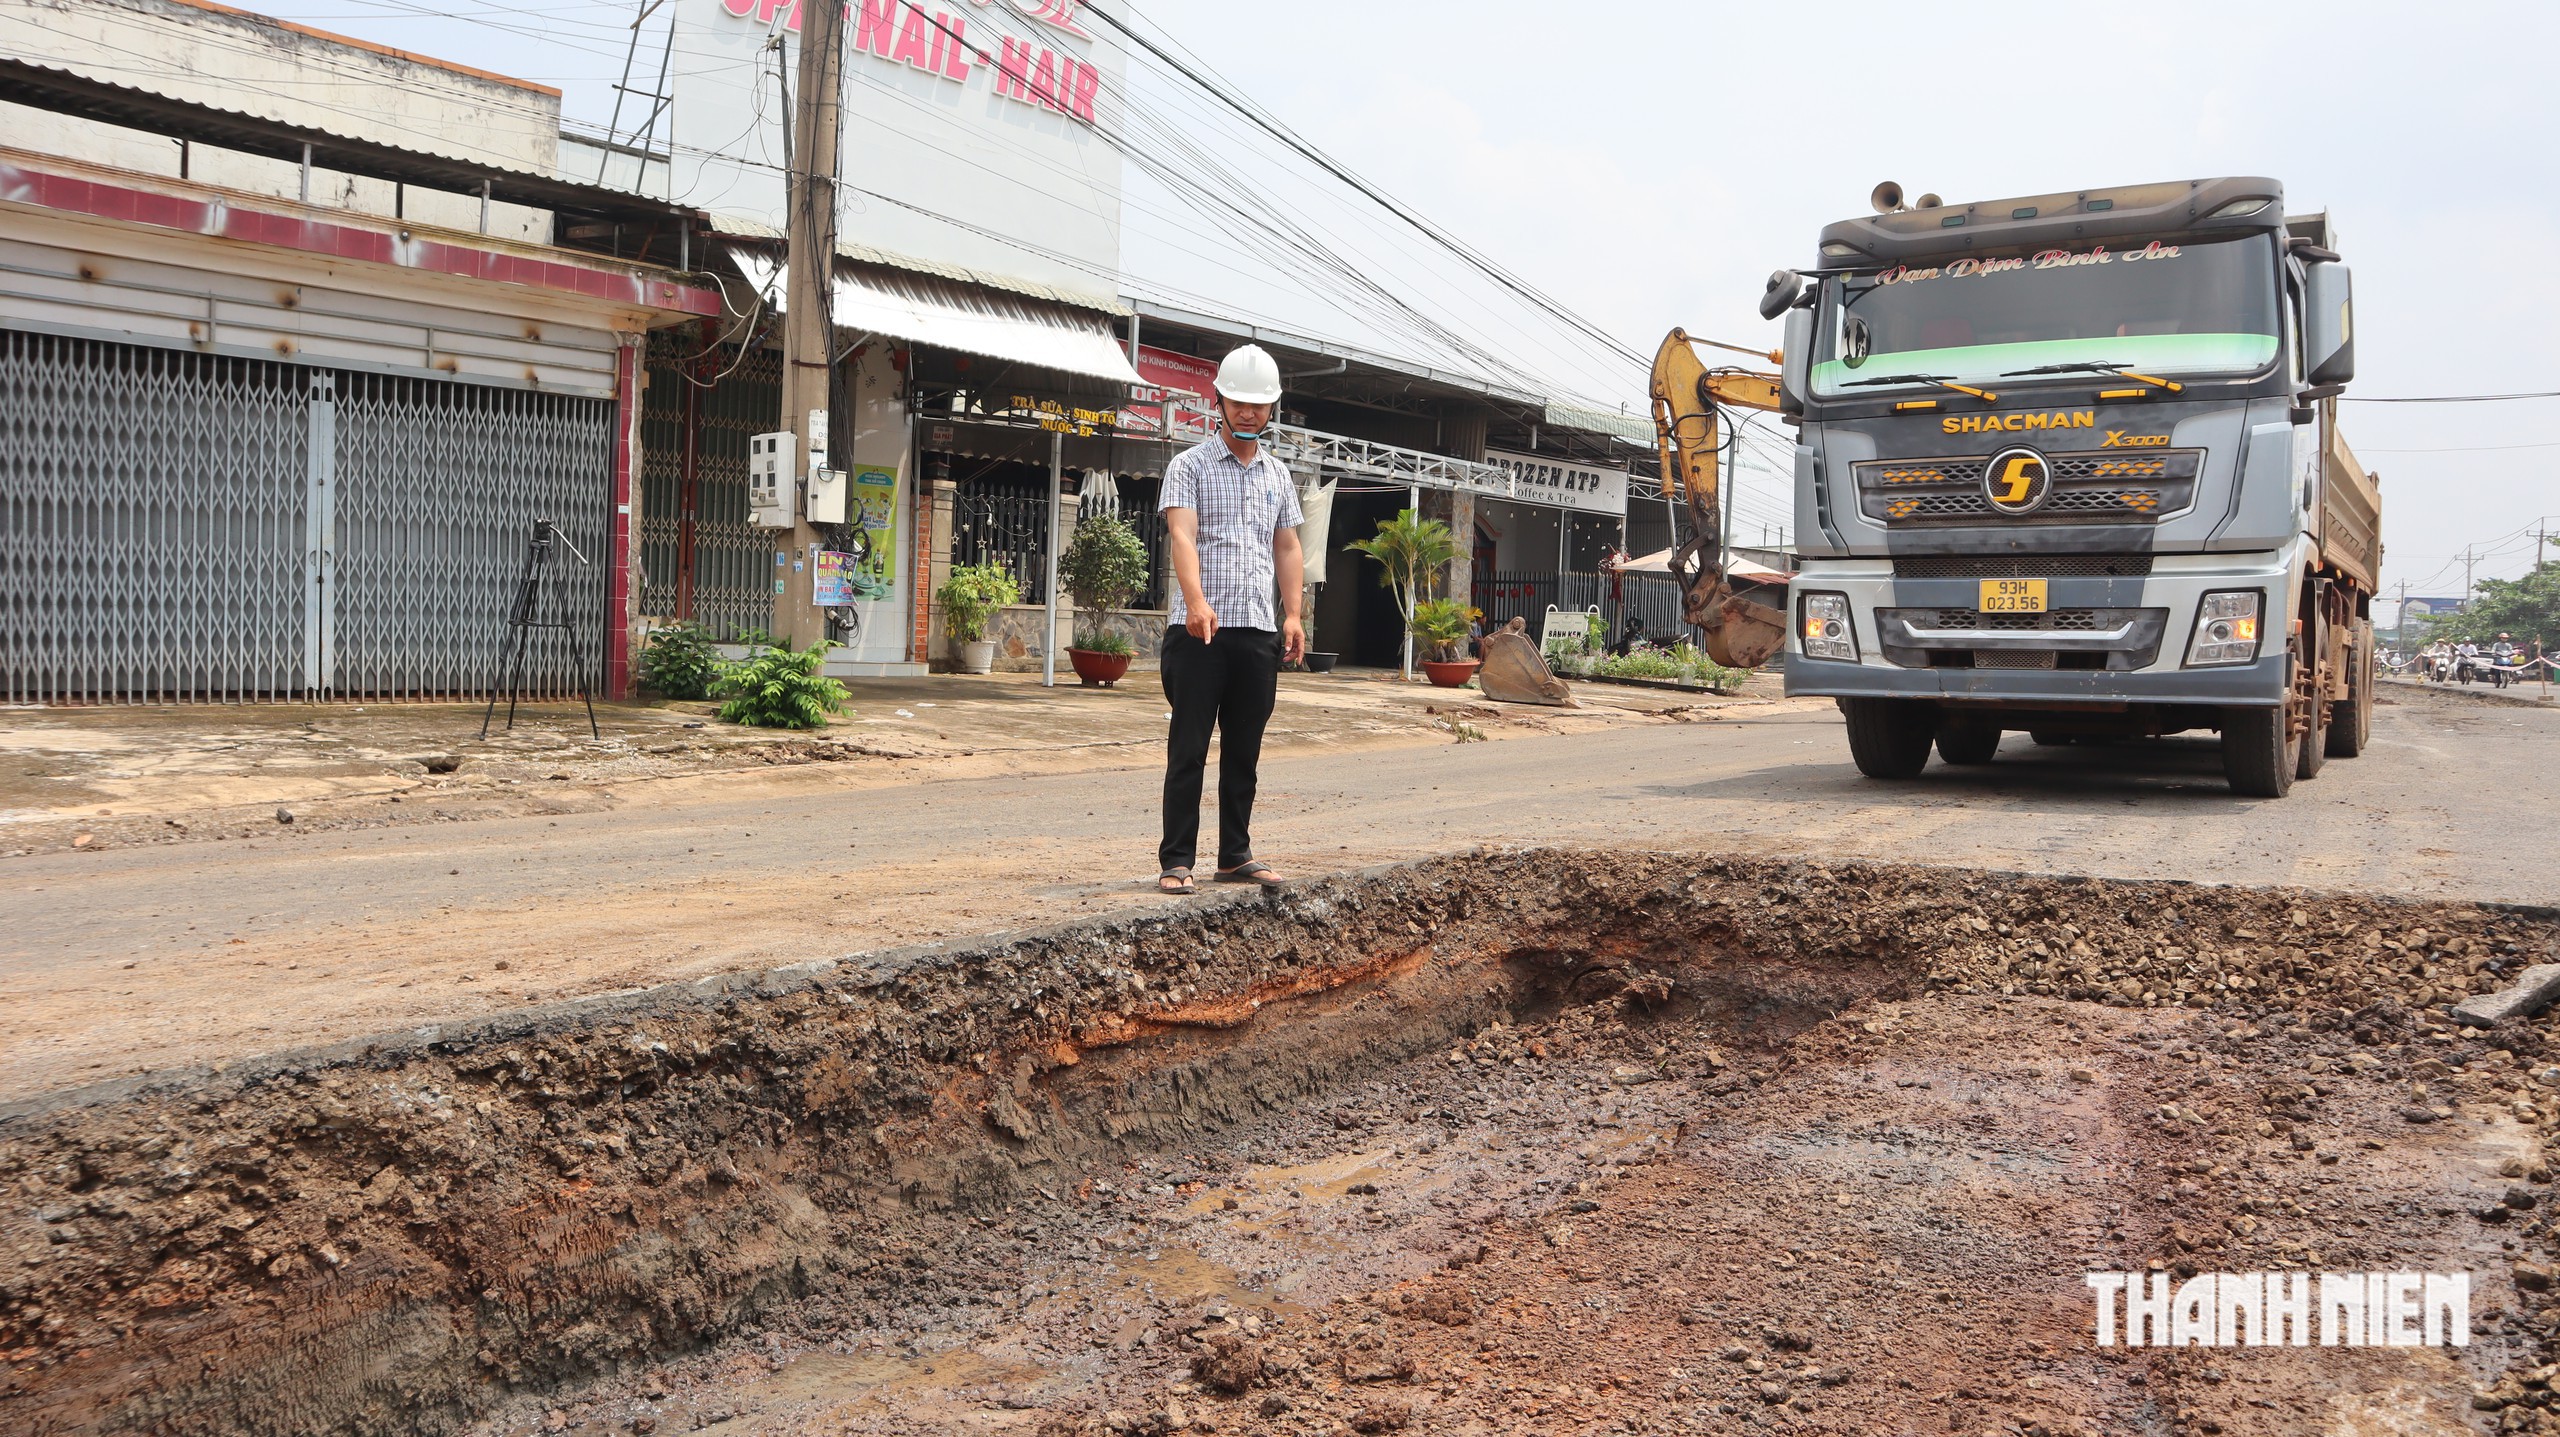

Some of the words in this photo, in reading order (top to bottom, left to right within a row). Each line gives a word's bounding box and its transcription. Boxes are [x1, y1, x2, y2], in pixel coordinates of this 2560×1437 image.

[2121, 240, 2182, 262] An
[1149, 356, 1167, 367] KINH
[1168, 361, 1194, 374] DOANH
[1195, 366, 1209, 377] LPG
[1011, 395, 1036, 409] TRÀ
[1073, 408, 1100, 423] SINH
[1102, 411, 1117, 425] TỐ
[1079, 423, 1093, 437] ÉP
[1942, 411, 2095, 434] SHACMAN
[2100, 430, 2170, 448] X3000
[1565, 470, 1600, 494] ATP
[1557, 493, 1576, 504] Tea
[1999, 582, 2027, 594] 93H
[1987, 597, 2039, 610] 023.56
